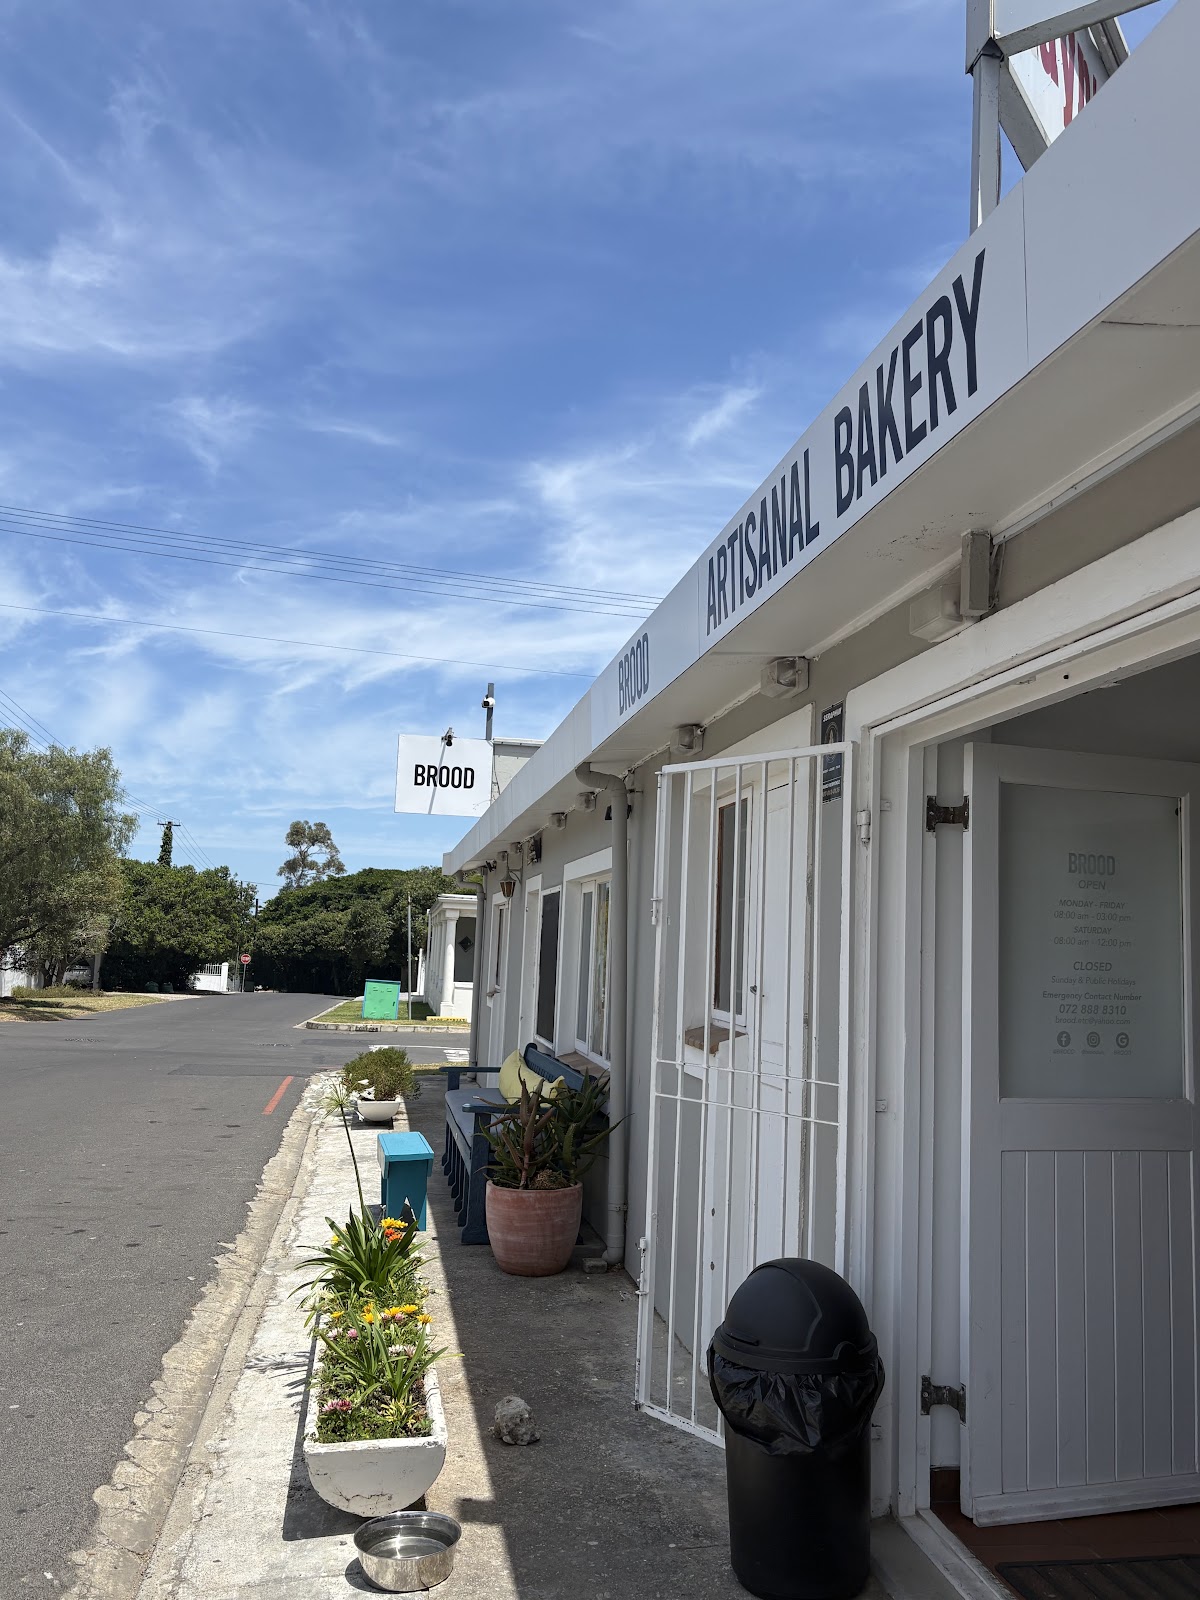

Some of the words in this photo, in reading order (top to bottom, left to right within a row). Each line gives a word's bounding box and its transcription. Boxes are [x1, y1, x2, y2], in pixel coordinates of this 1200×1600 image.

[706, 448, 819, 636] ARTISANAL
[834, 248, 985, 518] BAKERY
[618, 632, 650, 716] BROOD
[414, 764, 475, 789] BROOD
[1068, 852, 1115, 876] BROOD
[1078, 879, 1106, 890] OPEN
[1059, 899, 1093, 908] MONDAY
[1100, 901, 1125, 909] FRIDAY
[1054, 910, 1076, 919] 08:00
[1096, 912, 1117, 921] 03:00
[1119, 915, 1131, 923] pm
[1074, 926, 1112, 935] SATURDAY
[1054, 936, 1076, 945] 08:00
[1097, 938, 1117, 947] 12:00
[1073, 961, 1112, 971] CLOSED
[1051, 976, 1077, 985] Sunday
[1086, 977, 1105, 985] Public
[1108, 978, 1136, 987] Holidays
[1043, 991, 1082, 1001] Emergency
[1084, 992, 1112, 1000] Contact
[1114, 993, 1142, 1001] Number
[1059, 1004, 1077, 1014] 072
[1081, 1004, 1099, 1014] 888
[1102, 1005, 1127, 1015] 8310
